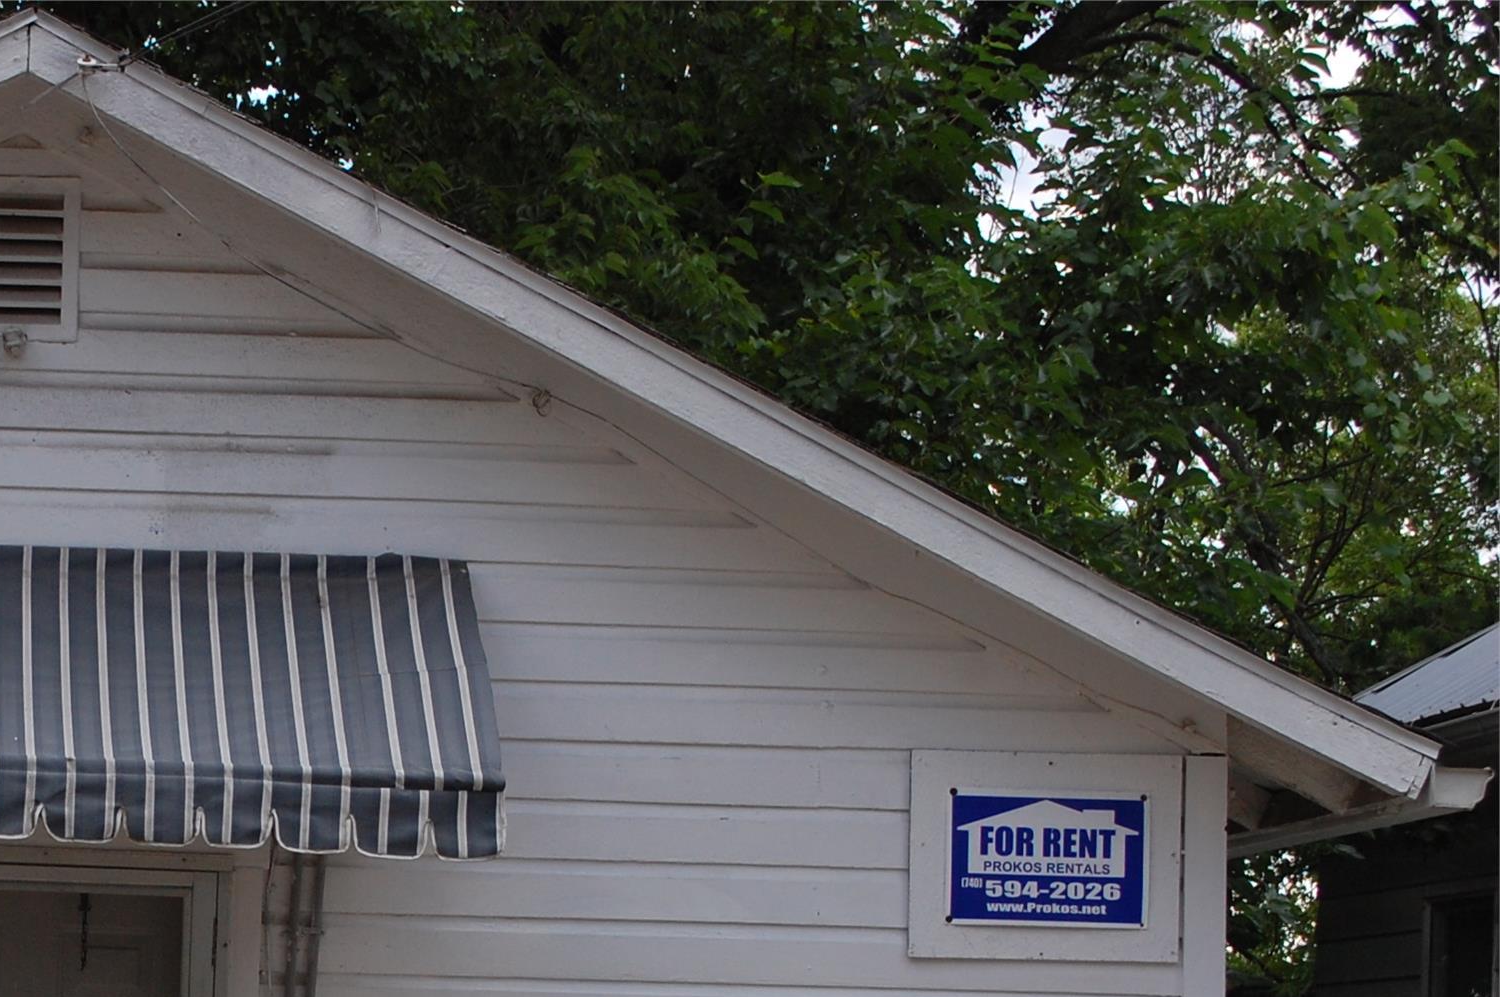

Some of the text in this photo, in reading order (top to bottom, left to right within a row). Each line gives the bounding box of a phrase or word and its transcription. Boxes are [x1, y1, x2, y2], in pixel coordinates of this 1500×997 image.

[979, 826, 1116, 859] FOR RENT
[983, 860, 1110, 875] PROKOS RENTALS
[961, 877, 1121, 900] (740) 594-2026
[986, 901, 1107, 915] www.Prokos.net
